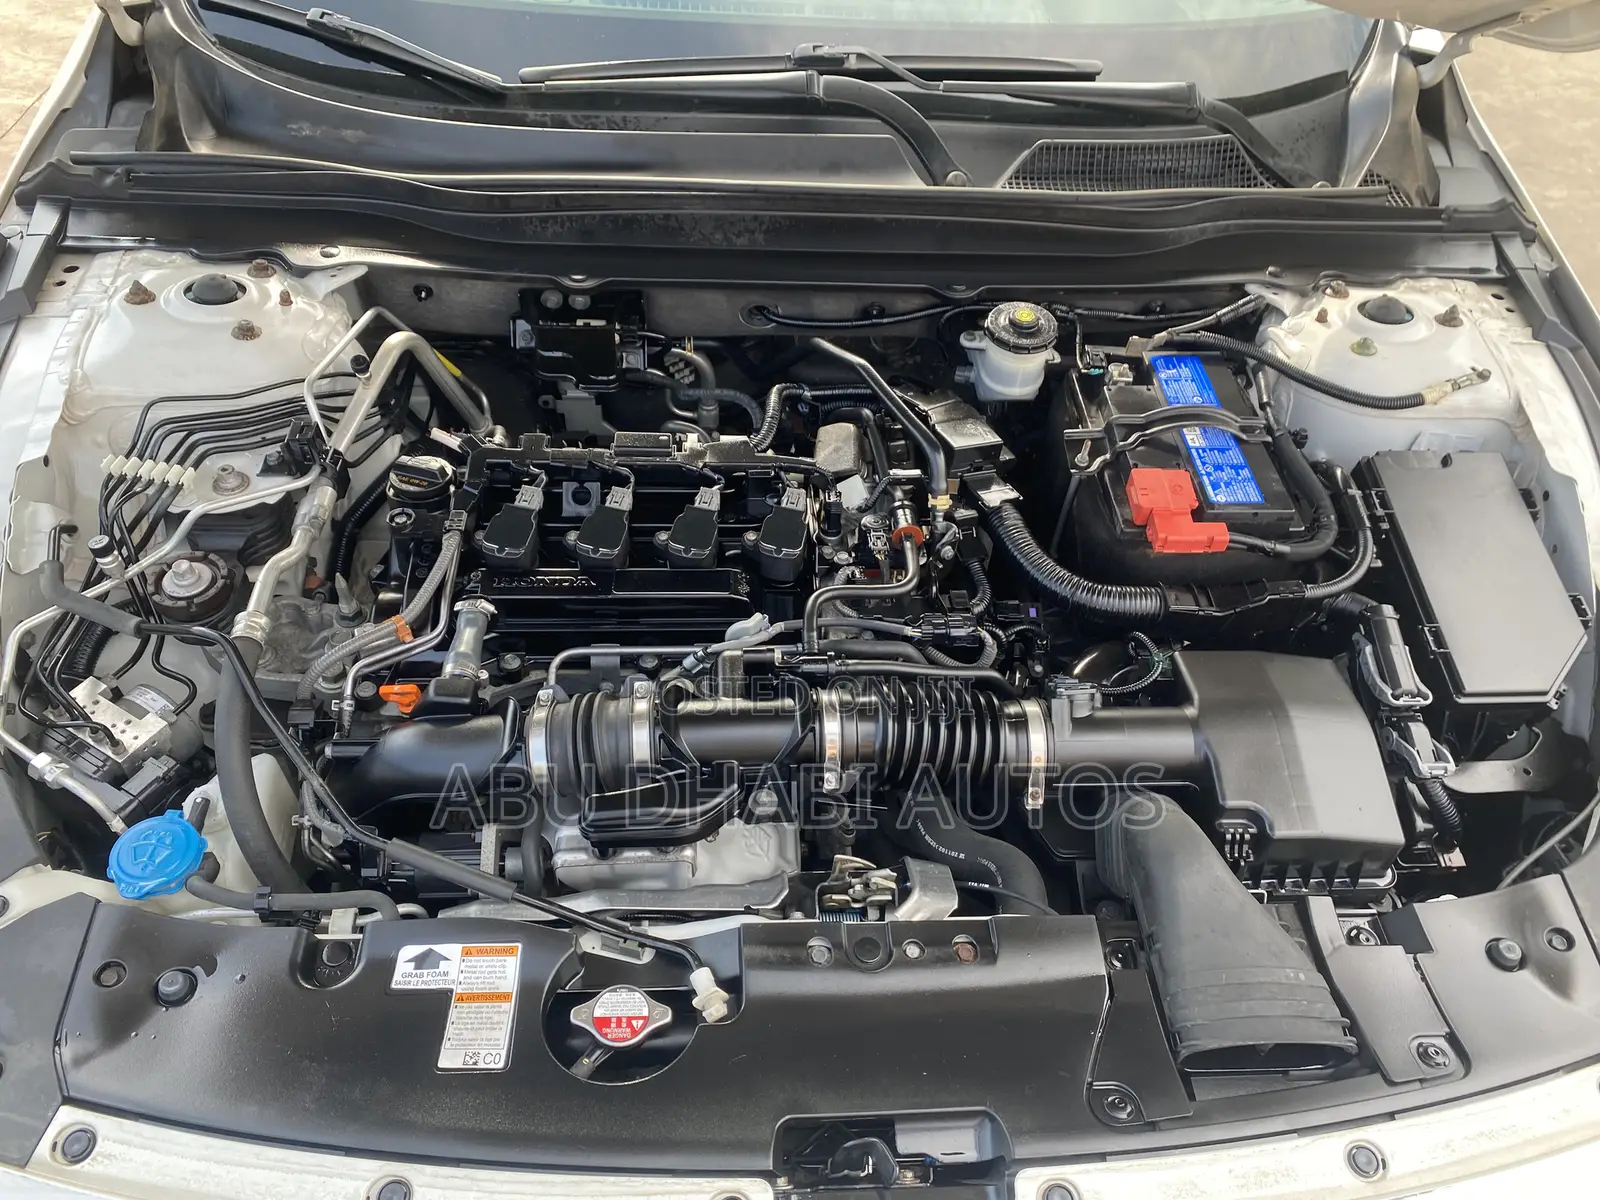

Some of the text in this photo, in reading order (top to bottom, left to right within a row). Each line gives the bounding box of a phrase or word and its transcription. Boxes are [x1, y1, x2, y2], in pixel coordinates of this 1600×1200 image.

[493, 576, 596, 588] HONDA
[476, 947, 514, 955] WARNING
[401, 970, 449, 979] GRAB FOAM
[394, 978, 456, 987] SAISIR LE PROTECTEUR
[465, 993, 511, 1002] AVERTISSEMENT
[483, 1052, 502, 1065] C0
